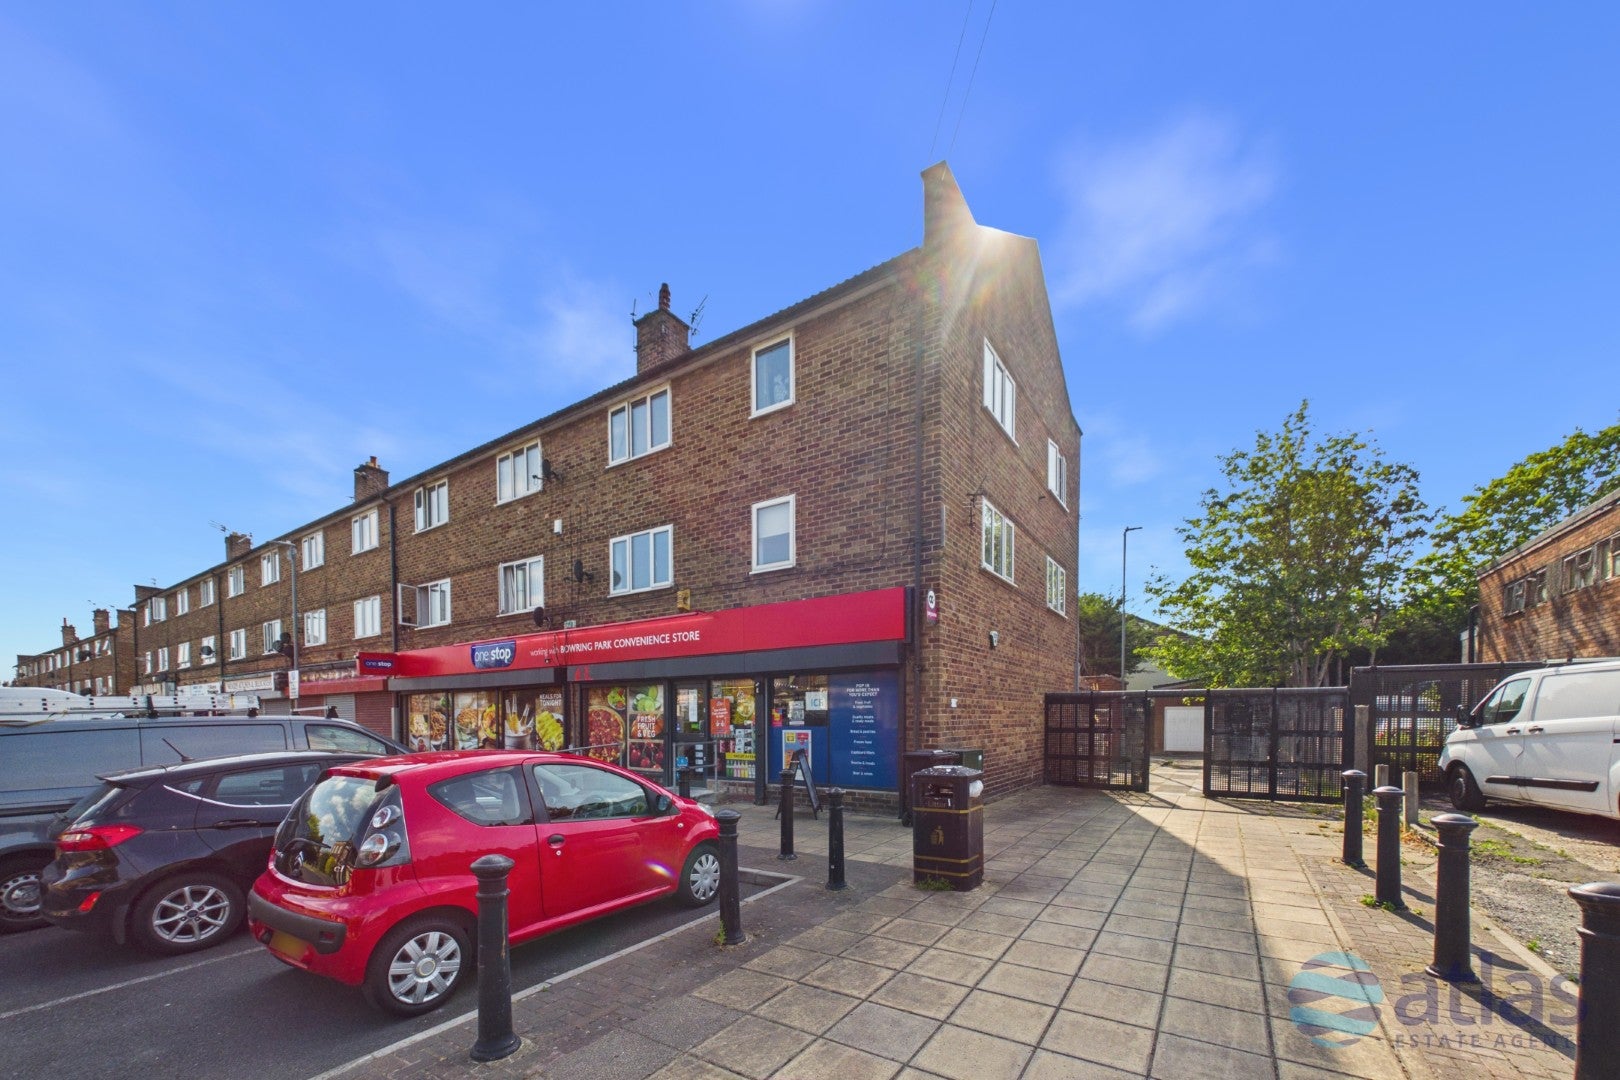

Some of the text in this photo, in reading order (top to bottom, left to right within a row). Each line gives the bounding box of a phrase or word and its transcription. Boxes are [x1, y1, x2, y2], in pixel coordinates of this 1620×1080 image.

[560, 642, 592, 654] BOWRING
[594, 639, 612, 651] PARK
[613, 634, 670, 649] CONVENIENCE
[672, 630, 700, 643] STORE
[474, 646, 511, 663] one stop
[377, 660, 392, 668] stop
[539, 699, 562, 707] TONIGHT
[637, 715, 656, 723] FRESH
[637, 722, 656, 730] FRUIT
[637, 730, 656, 738] & VEG
